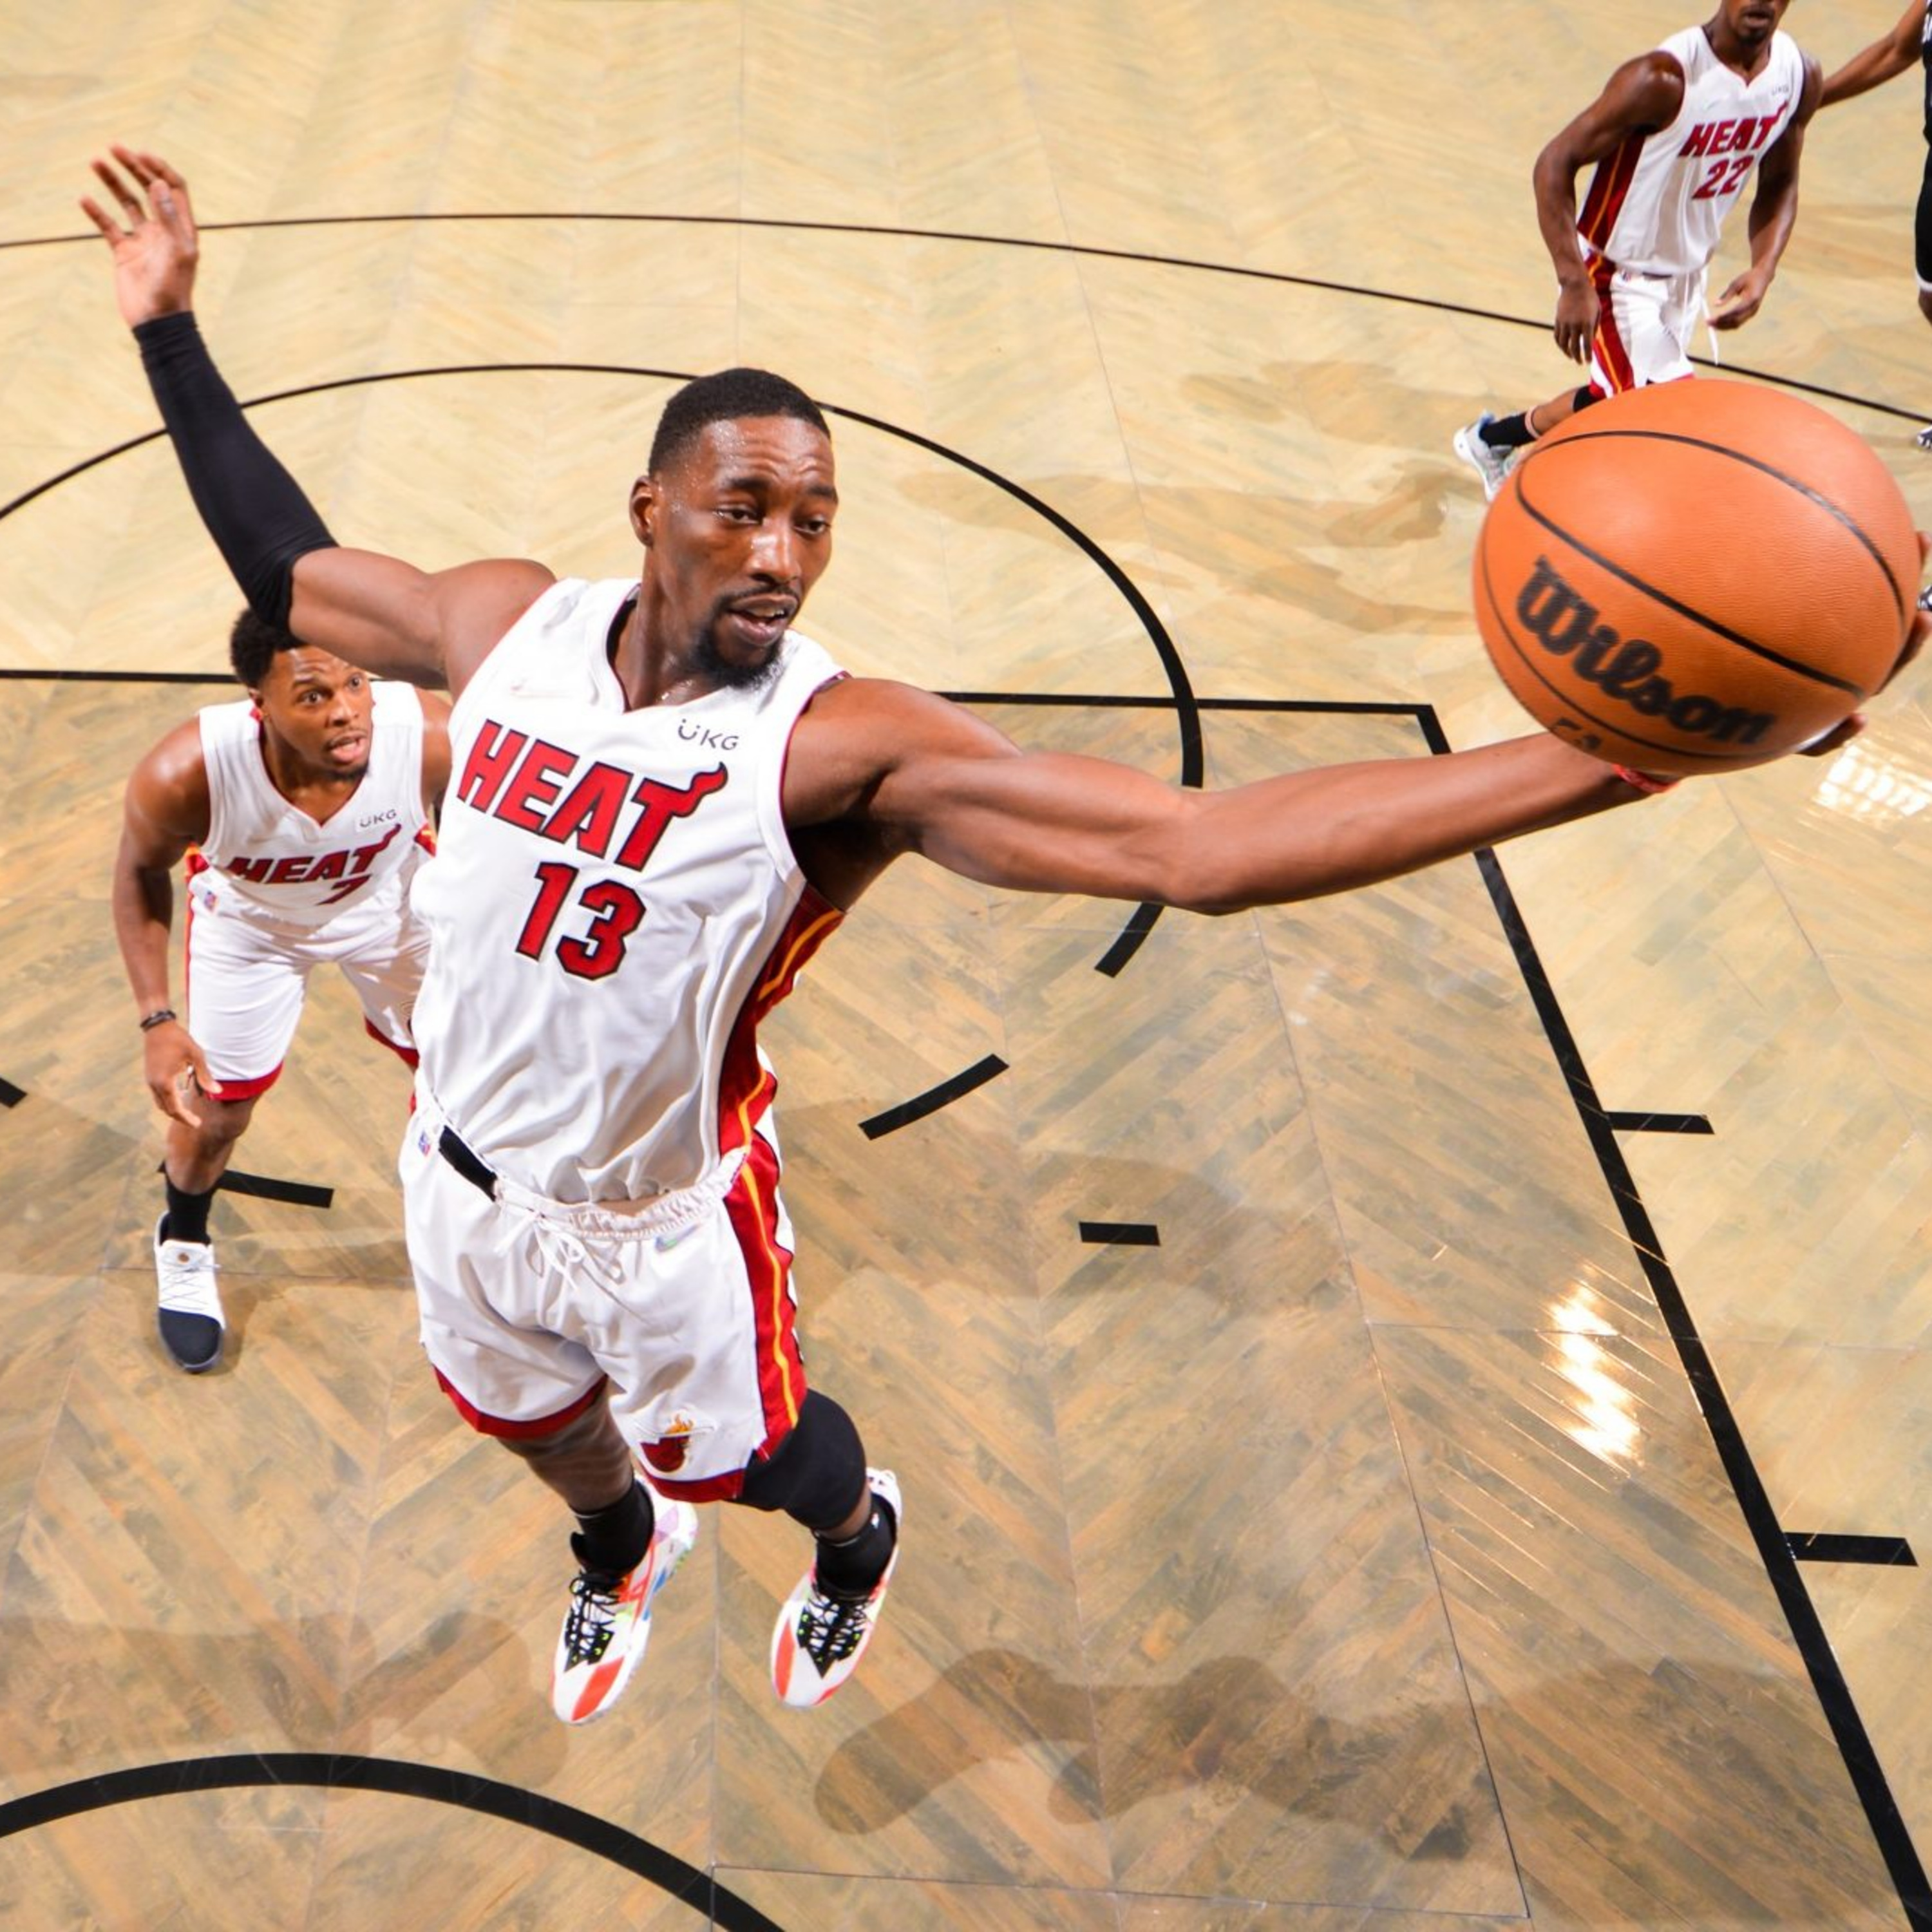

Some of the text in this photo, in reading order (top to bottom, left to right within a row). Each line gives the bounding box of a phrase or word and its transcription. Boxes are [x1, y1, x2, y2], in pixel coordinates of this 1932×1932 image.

[1677, 99, 1788, 157] HEAT
[1692, 155, 1754, 200] 22
[1516, 554, 1777, 744] Wilson
[457, 719, 728, 872] HEAT
[226, 823, 402, 884] HEAT
[316, 874, 372, 905] 7
[515, 861, 647, 981] 13
